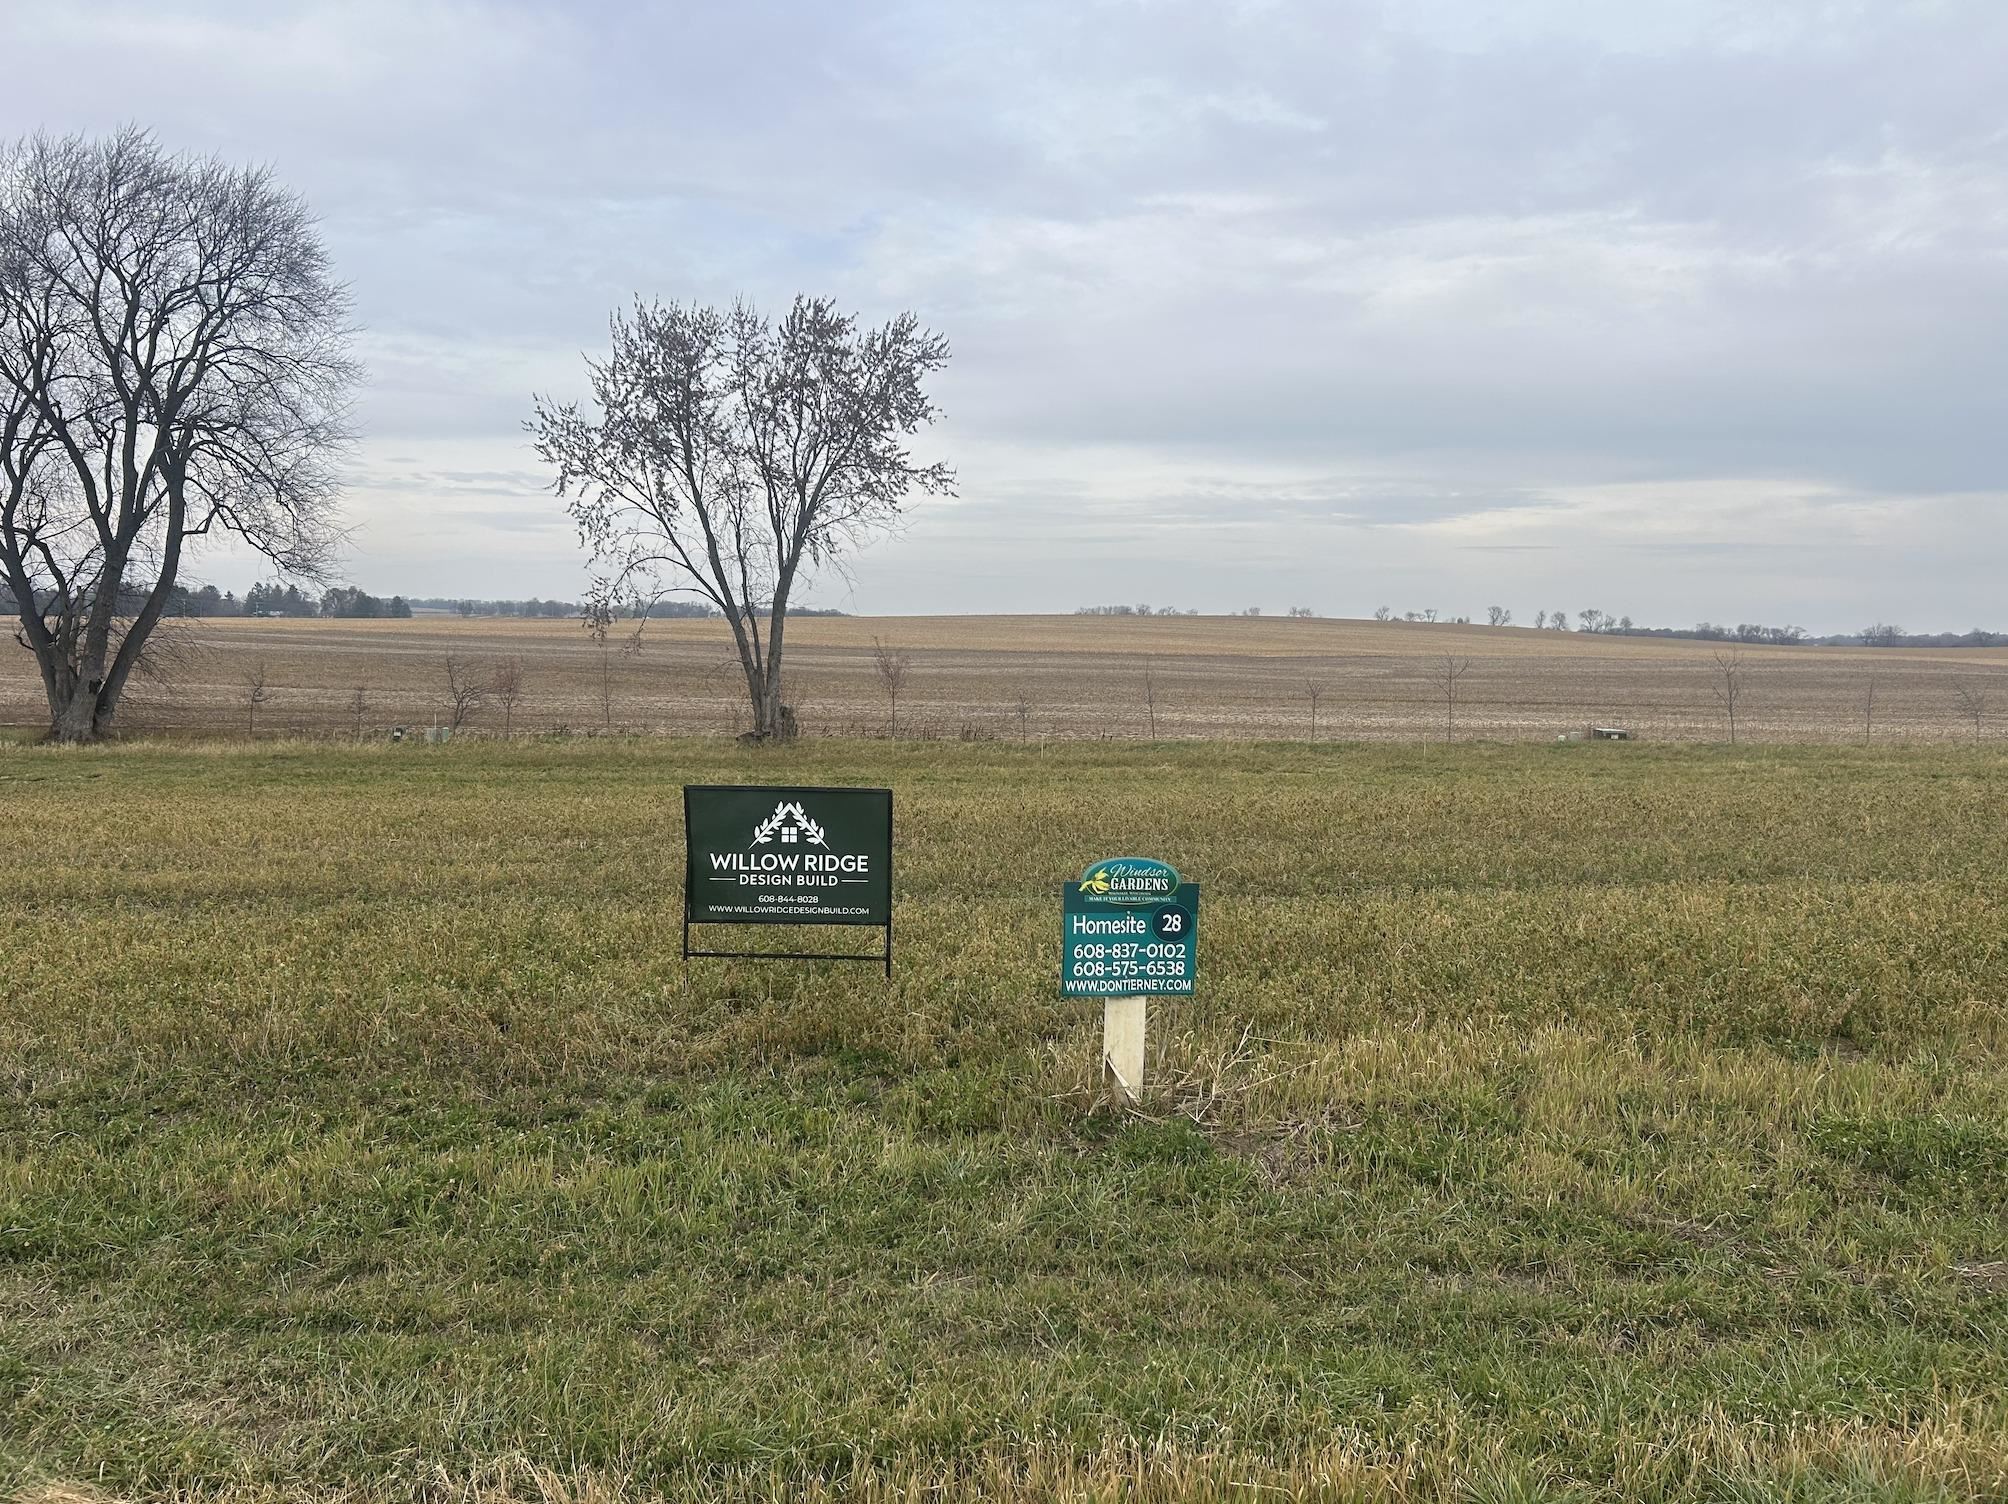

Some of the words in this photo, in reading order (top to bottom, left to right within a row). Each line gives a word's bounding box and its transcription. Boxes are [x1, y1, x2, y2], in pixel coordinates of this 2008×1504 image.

[709, 853, 800, 871] WILLOW
[804, 854, 869, 873] RIDGE
[1110, 863, 1169, 877] Windsor
[739, 874, 792, 885] DESIGN
[796, 875, 838, 886] BUILD
[1110, 877, 1169, 891] GARDENS
[758, 895, 819, 904] 608-844-8028
[708, 905, 869, 915] WWW.WILLOWRIDGEDESIGNBUILD.COM
[1073, 915, 1146, 934] Homesite
[1162, 914, 1182, 932] 28
[1073, 943, 1186, 959] 608-837-0102
[1073, 961, 1185, 976] 608-575-6538
[1065, 979, 1192, 992] WWW.DONTIERNEY.COM
